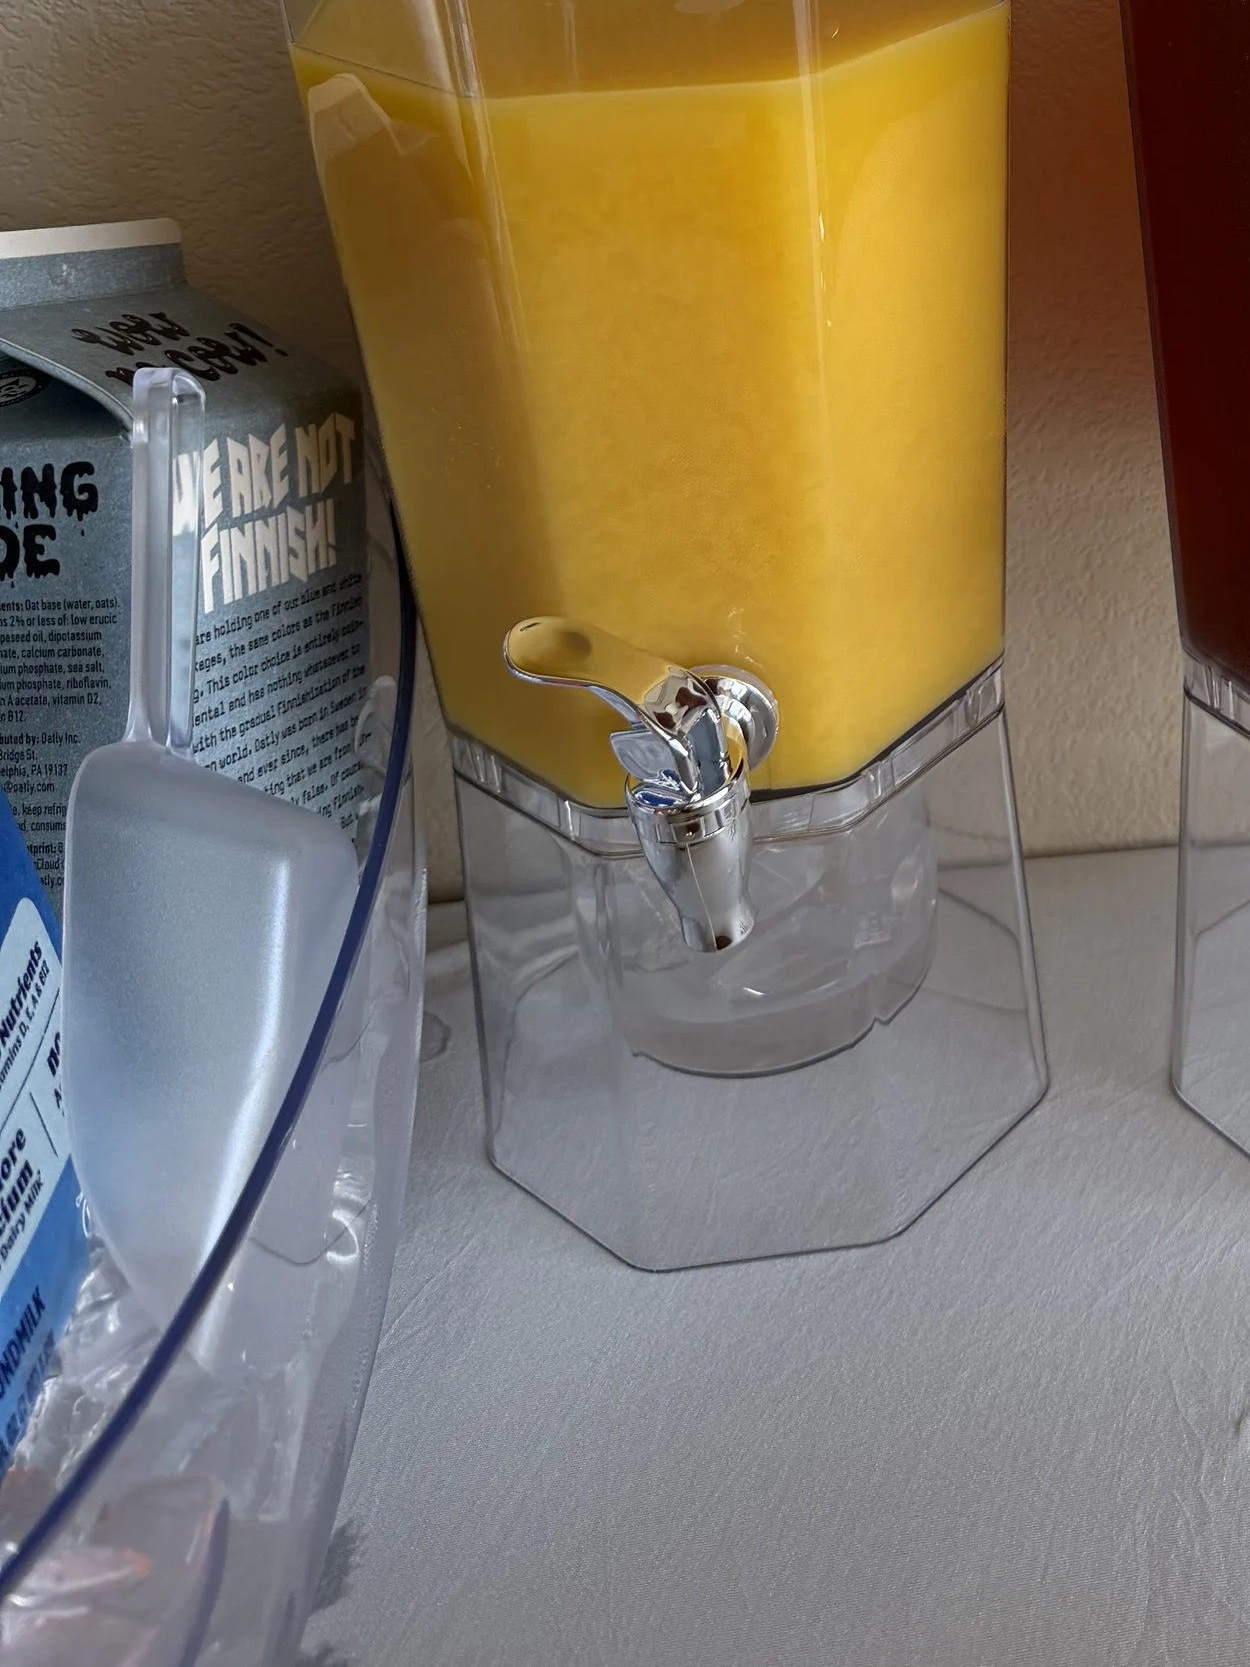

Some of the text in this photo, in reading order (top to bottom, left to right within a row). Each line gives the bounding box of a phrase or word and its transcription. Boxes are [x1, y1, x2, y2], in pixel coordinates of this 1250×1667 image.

[173, 411, 356, 537] WE ARE NOT
[201, 498, 338, 614] FINNISH!
[25, 599, 40, 611] Oat
[41, 599, 62, 611] base
[63, 598, 94, 611] (water,
[95, 597, 121, 609] oats).
[26, 617, 36, 627] or
[38, 615, 56, 627] less
[71, 614, 88, 626] low
[89, 612, 118, 625] erucic
[213, 614, 254, 640] holding
[254, 608, 270, 623] one
[272, 600, 282, 615] of
[284, 597, 299, 611] our
[32, 631, 47, 643] oil,
[48, 630, 103, 644] dipotassium
[229, 641, 246, 659] the
[248, 634, 270, 652] same
[271, 621, 301, 642] colors
[21, 645, 56, 659] calcium
[57, 645, 105, 658] carbonate,
[18, 662, 66, 677] phosphate,
[67, 664, 83, 674] sea
[85, 661, 105, 674] salt,
[206, 675, 230, 695] This
[232, 665, 260, 685] color
[261, 650, 291, 672] choice
[292, 643, 302, 659] is
[16, 677, 65, 692] phosphate,
[66, 676, 112, 690] riboflavin,
[228, 692, 247, 713] and
[248, 685, 265, 704] has
[266, 670, 304, 695] nothing
[15, 696, 51, 707] acetate,
[52, 693, 85, 706] vitamin
[26, 732, 40, 746] by:
[41, 731, 64, 747] Oatly
[65, 731, 82, 744] Inc.
[192, 732, 218, 754] with
[219, 725, 237, 742] the
[239, 704, 276, 737] gradual
[26, 748, 38, 761] St.
[219, 743, 253, 770] world.
[254, 730, 279, 753] Oatly
[281, 722, 298, 740] was
[32, 764, 42, 775] PA
[257, 758, 278, 778] ever
[281, 743, 309, 766] since,
[286, 767, 306, 788] that
[22, 802, 43, 817] keep
[0, 940, 43, 1047] Nutrients
[0, 1212, 26, 1262] Dairy
